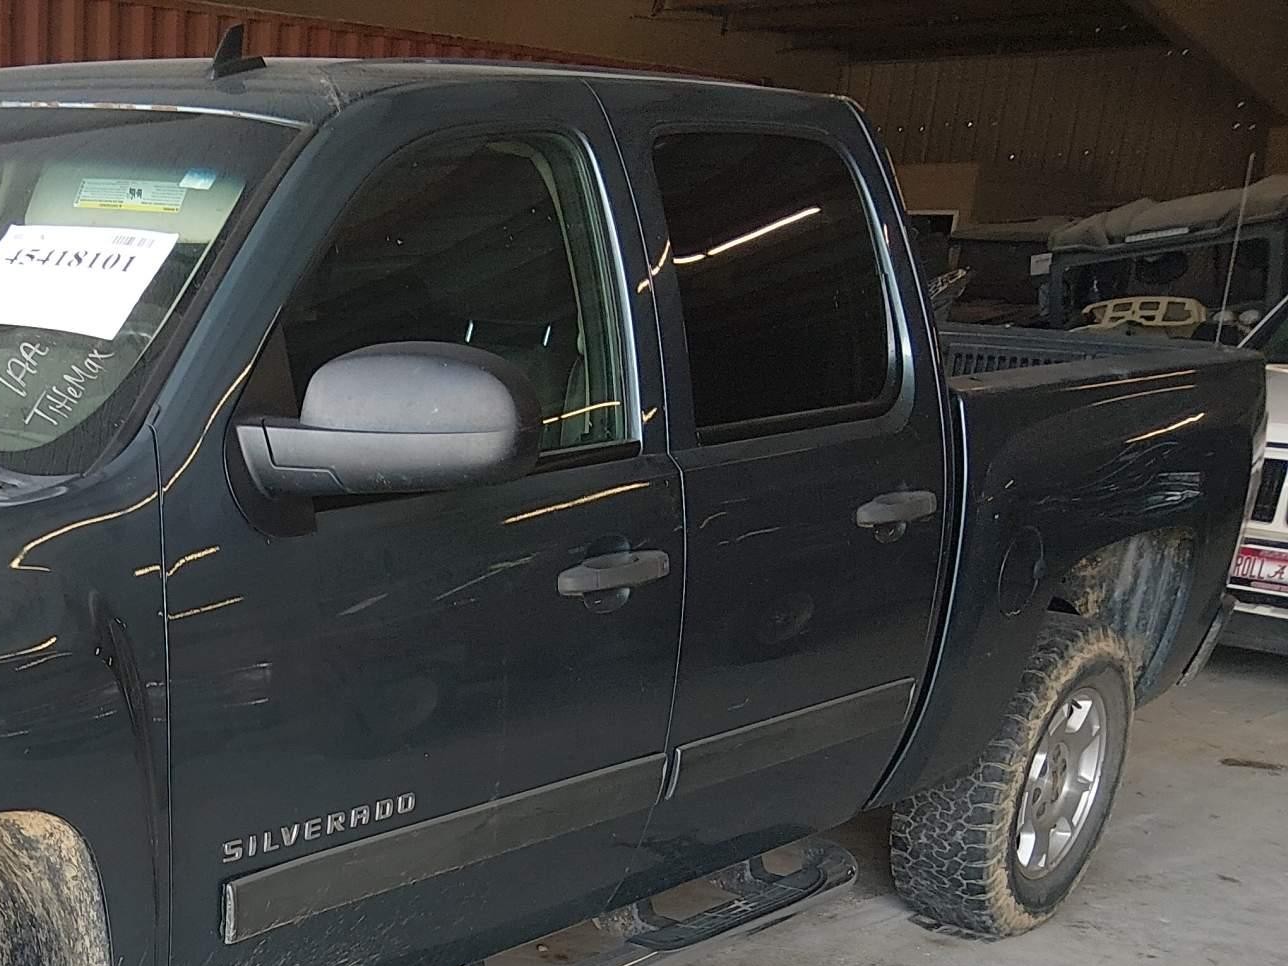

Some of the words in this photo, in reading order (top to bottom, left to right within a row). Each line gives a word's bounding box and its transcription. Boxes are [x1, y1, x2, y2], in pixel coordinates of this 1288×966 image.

[5, 249, 137, 273] 45418101
[1232, 554, 1265, 580] ROLL
[222, 791, 417, 864] SILVERADO
